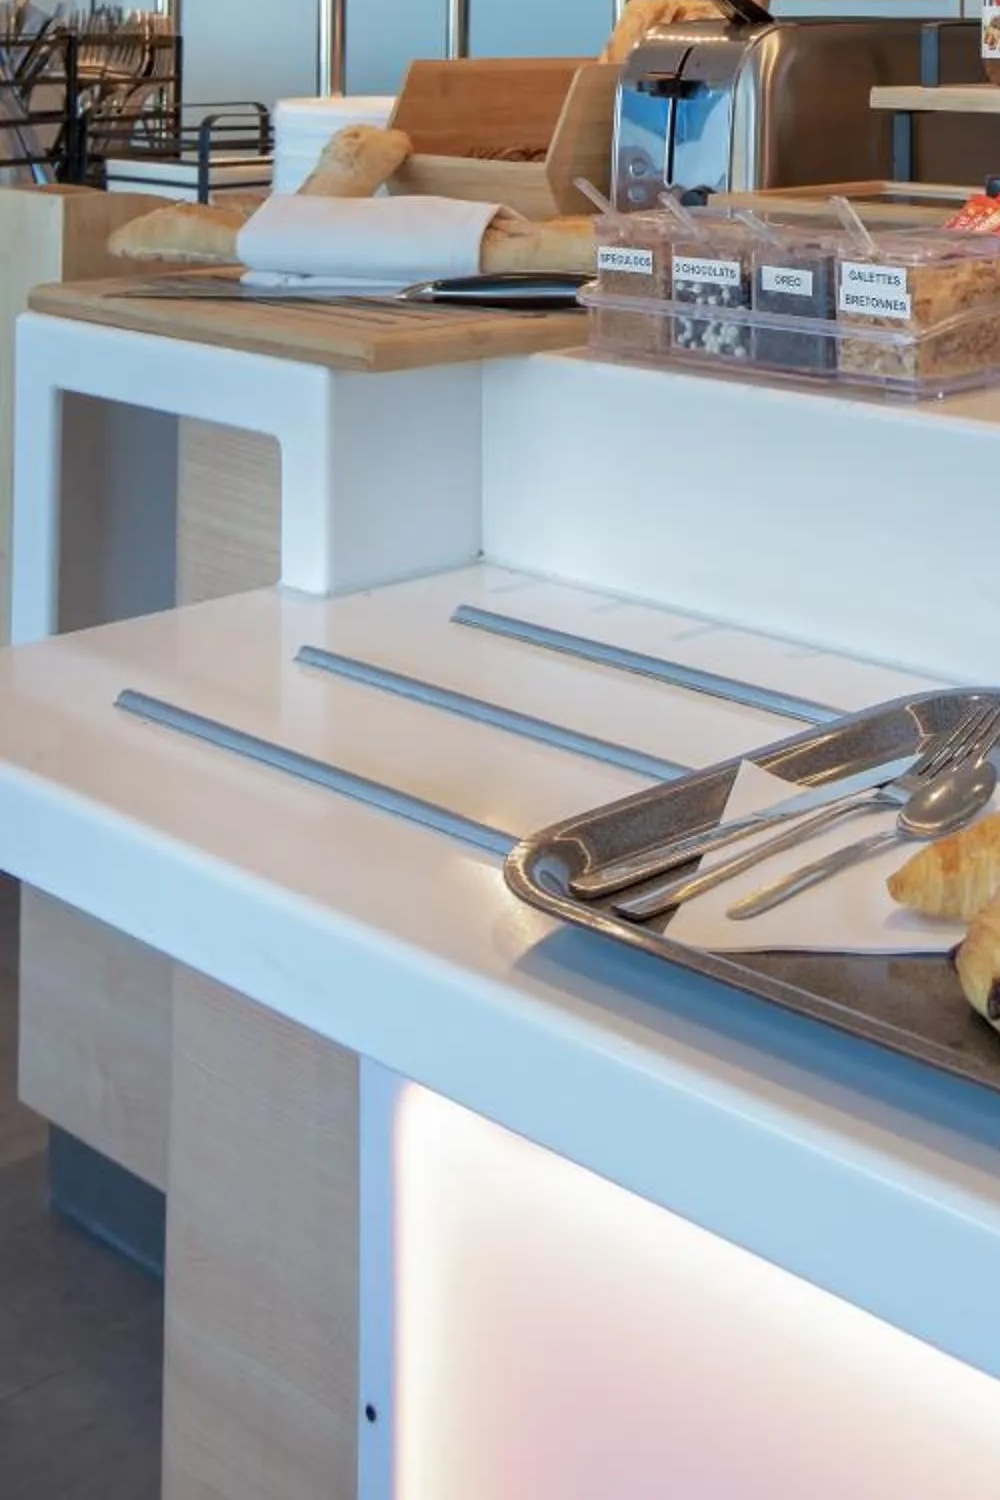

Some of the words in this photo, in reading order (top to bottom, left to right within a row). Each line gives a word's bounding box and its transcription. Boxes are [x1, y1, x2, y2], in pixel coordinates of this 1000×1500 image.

[682, 263, 736, 279] CHOCOLATS
[848, 269, 901, 286] GALETTES
[774, 274, 801, 288] OREO
[845, 293, 907, 312] BRETONNES
